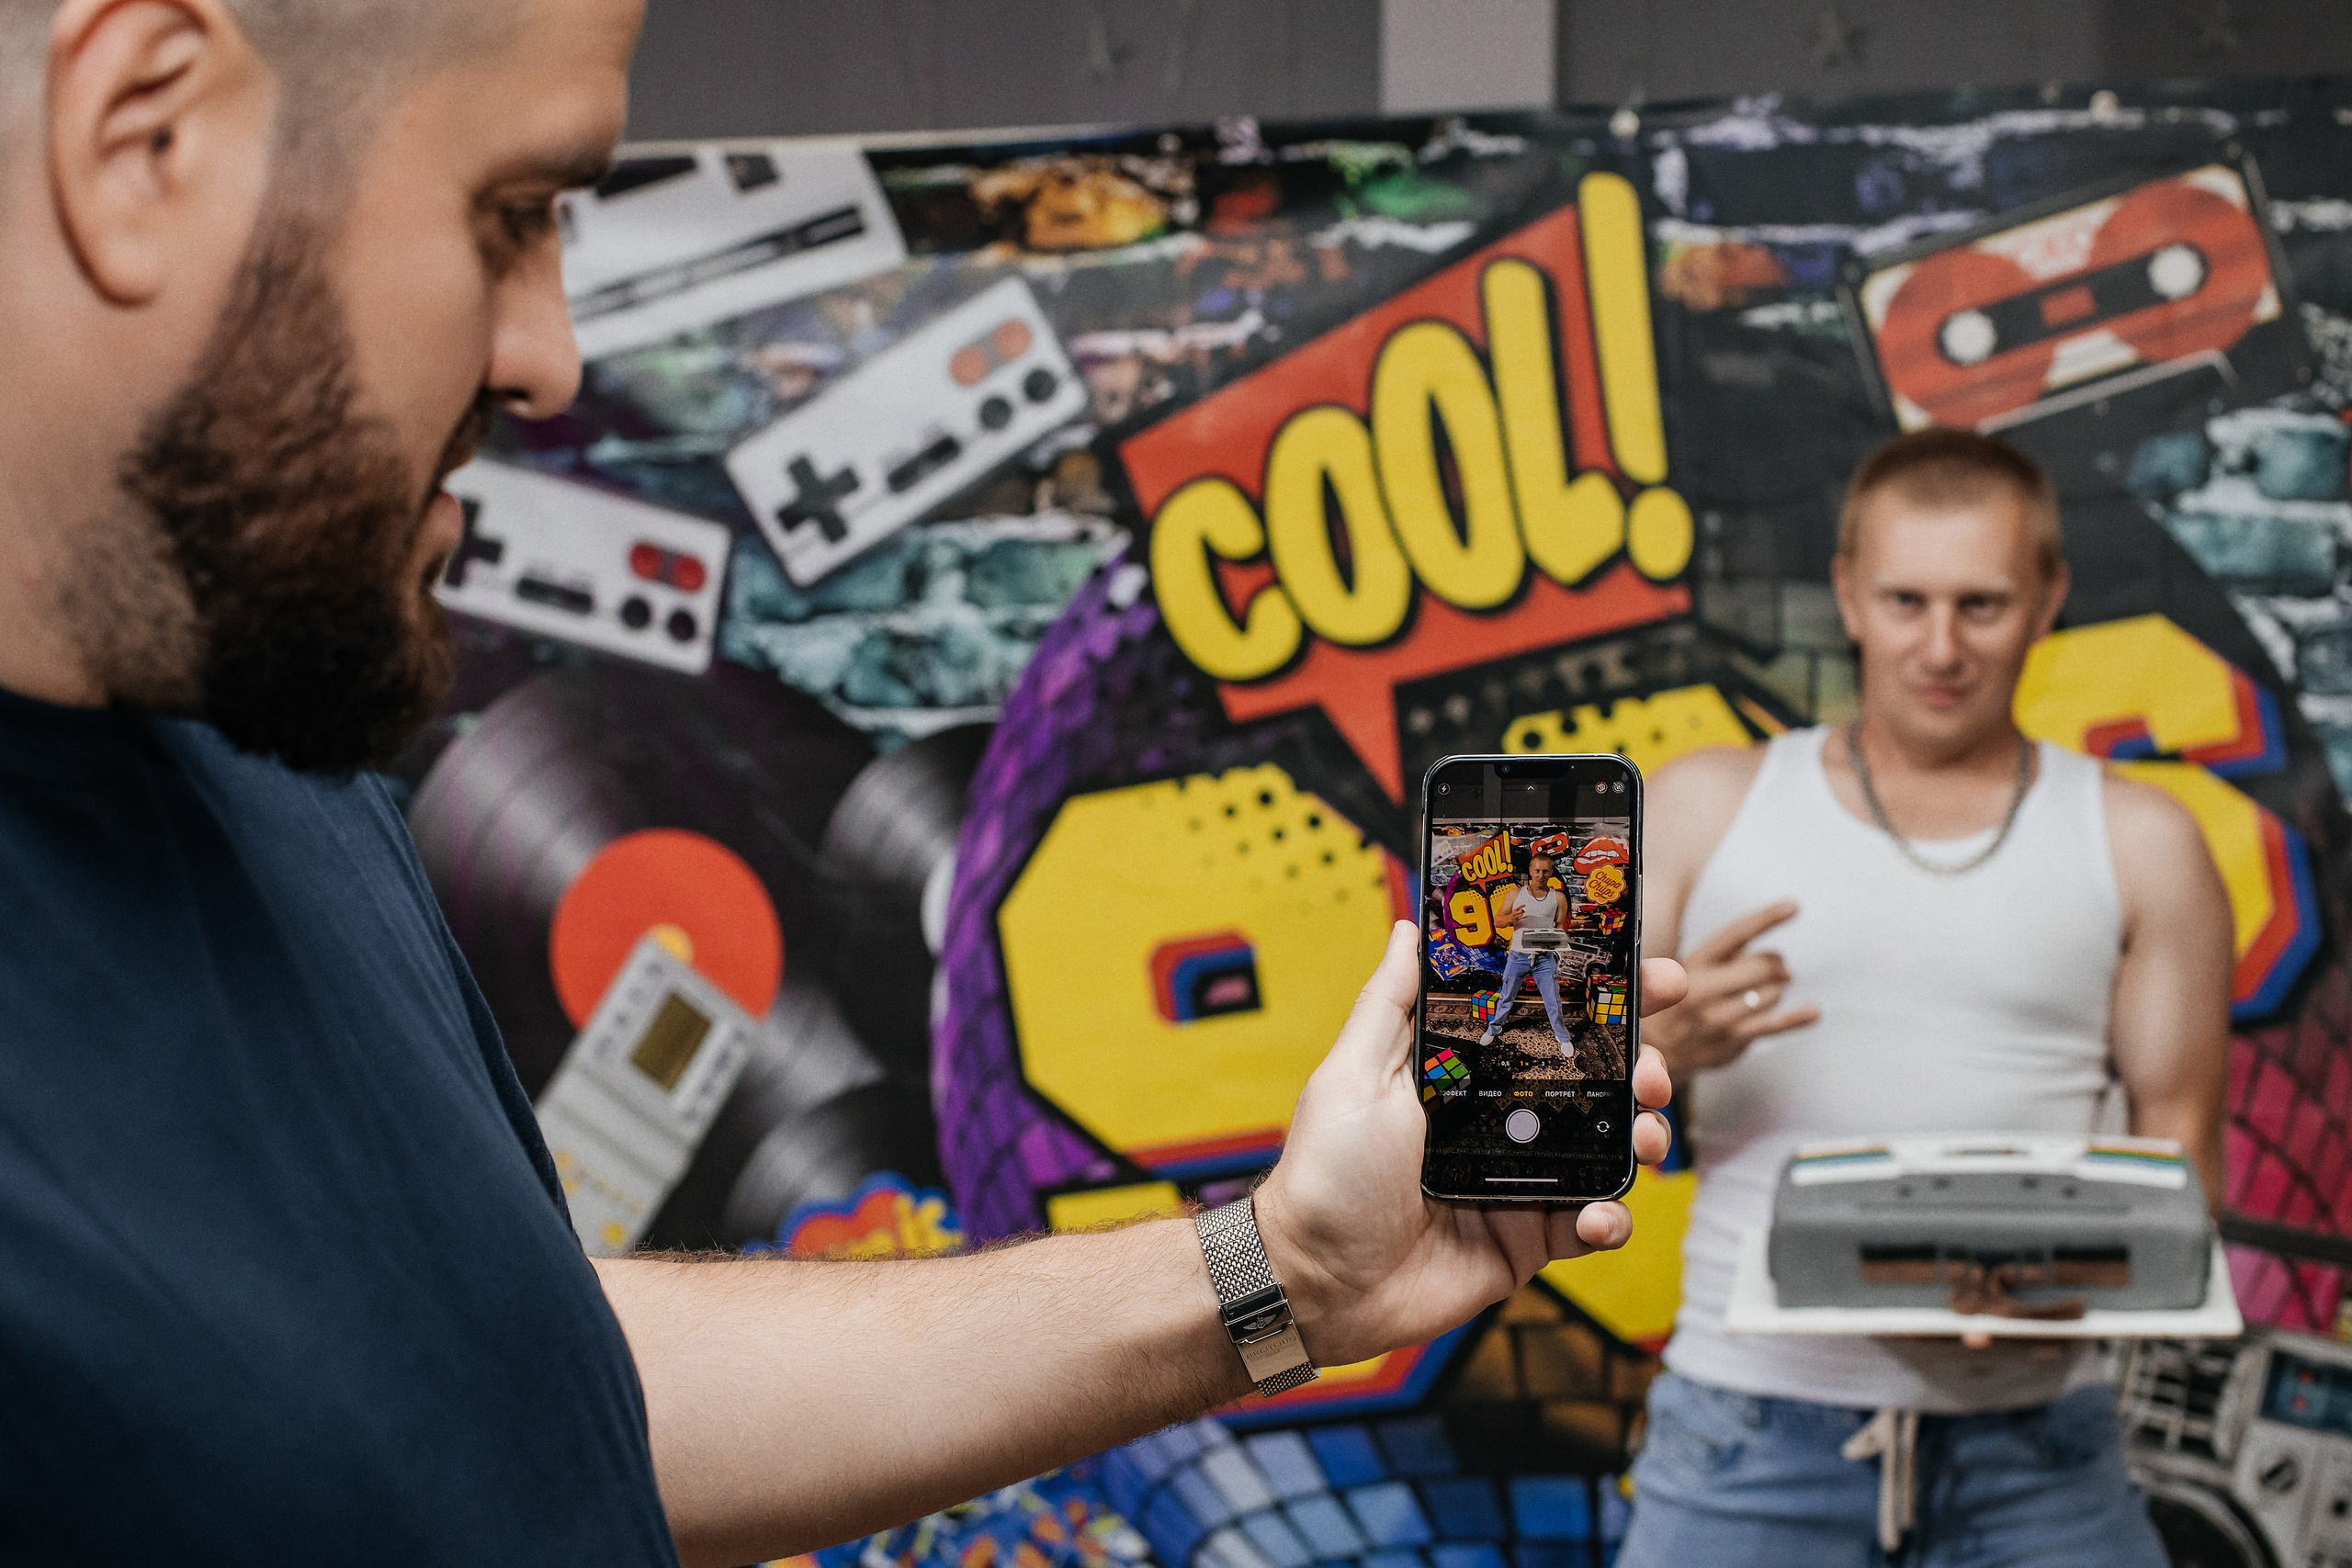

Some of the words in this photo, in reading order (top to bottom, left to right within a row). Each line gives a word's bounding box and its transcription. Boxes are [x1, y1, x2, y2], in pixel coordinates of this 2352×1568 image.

[1148, 171, 1695, 682] COOL!
[1461, 829, 1514, 882] COOL!
[1589, 879, 1615, 899] Chups
[1595, 871, 1622, 889] Chupa
